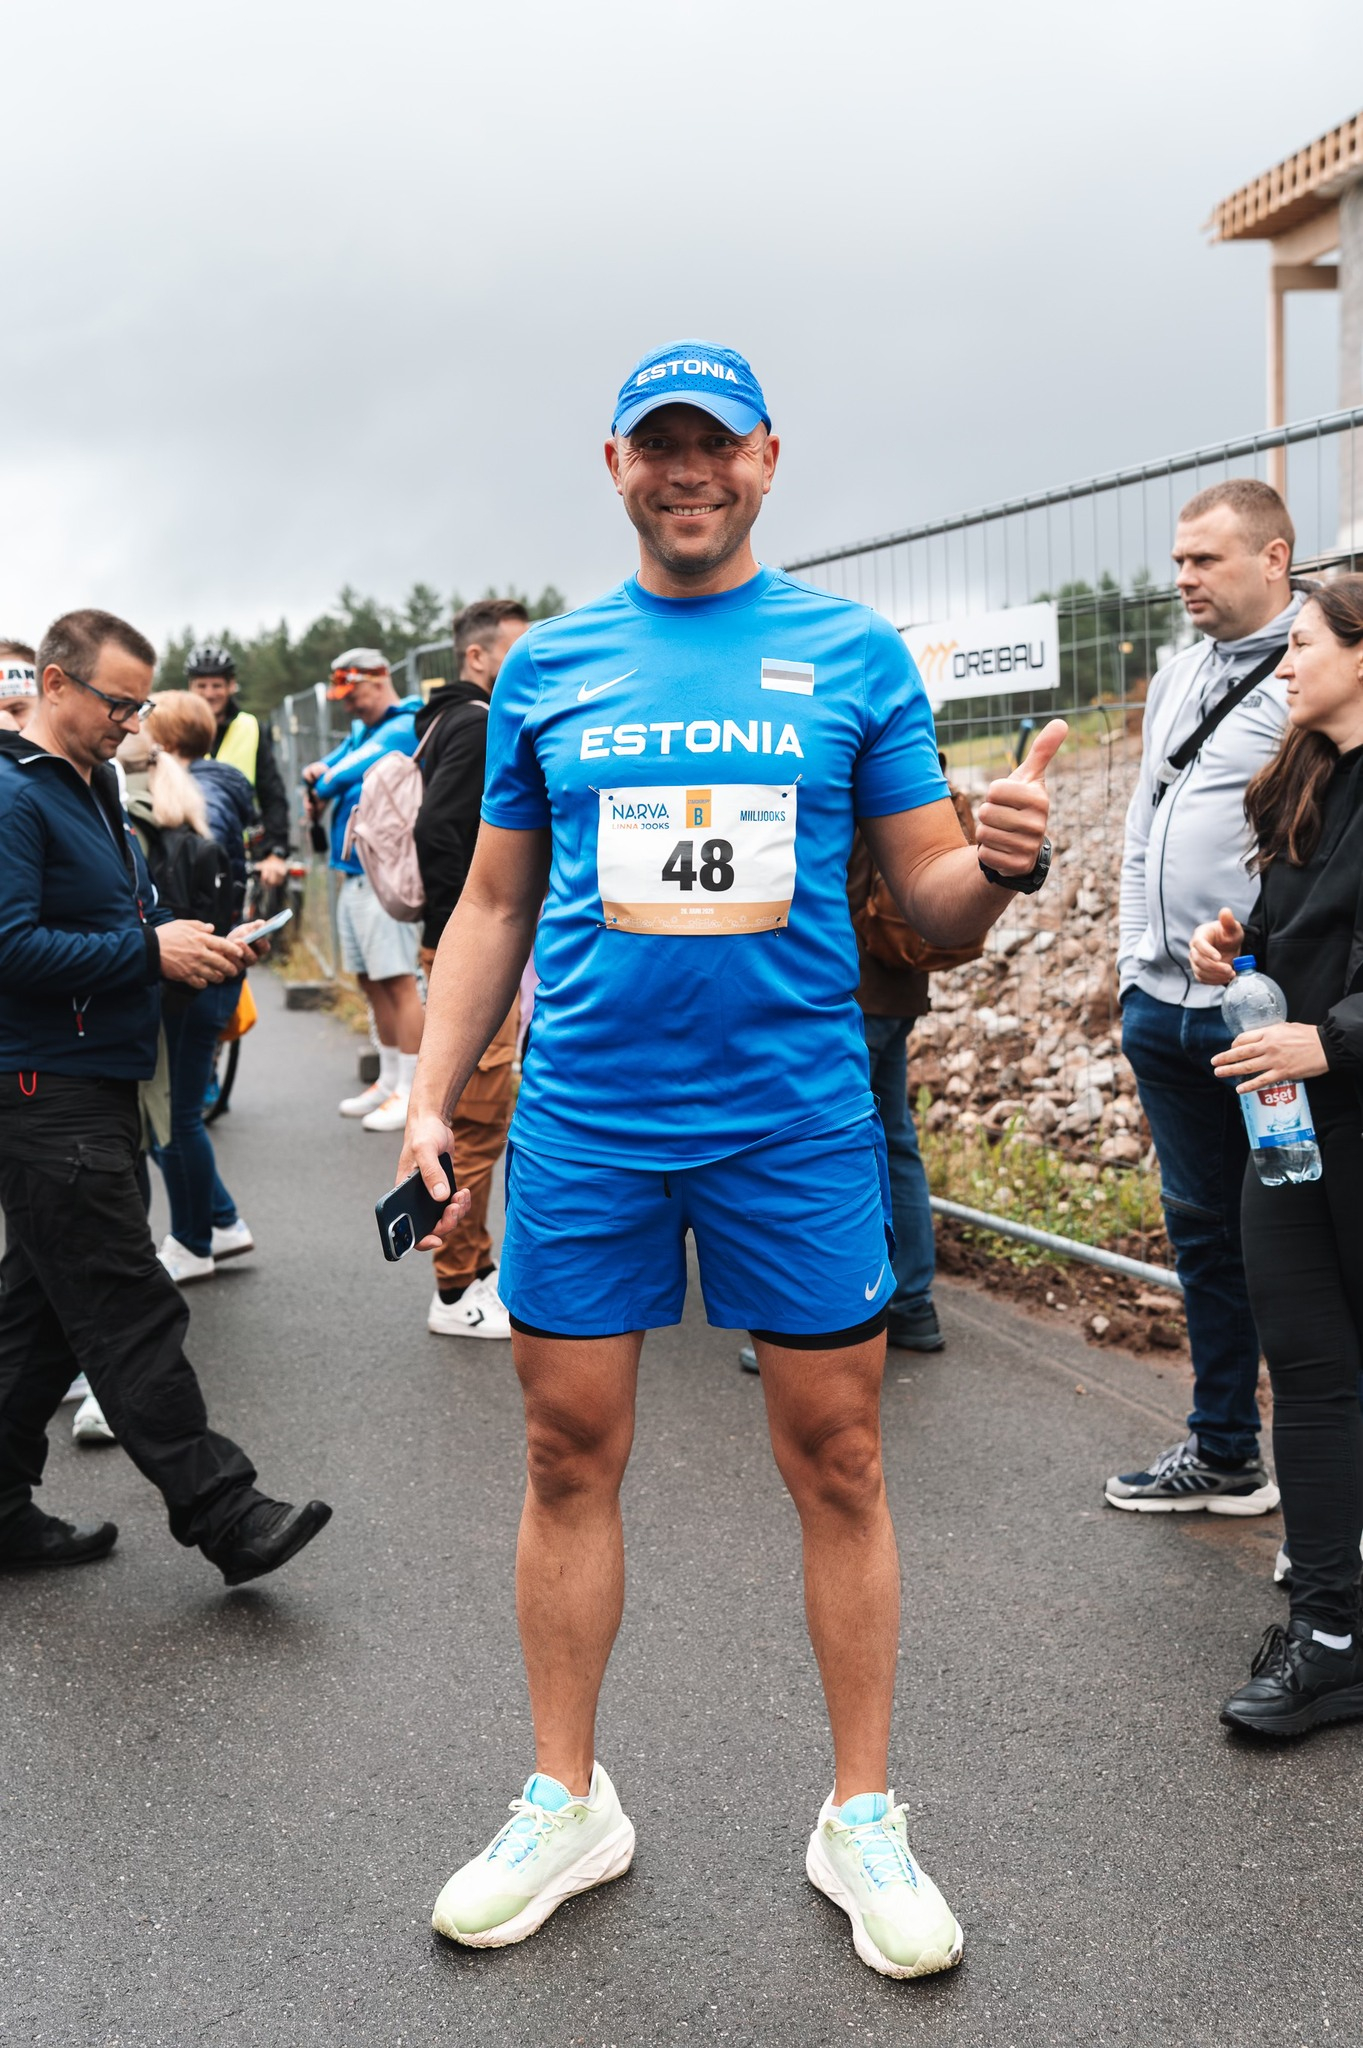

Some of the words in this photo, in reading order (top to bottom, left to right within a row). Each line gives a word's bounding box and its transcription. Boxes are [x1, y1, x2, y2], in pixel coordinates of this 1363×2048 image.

[636, 359, 738, 386] ESTONIA
[953, 640, 1044, 679] DREIBAU
[579, 719, 804, 760] ESTONIA
[612, 803, 669, 820] NARVA
[694, 807, 703, 826] B
[740, 810, 786, 822] MIILIJOOKS
[640, 822, 670, 830] JOOKS
[661, 838, 735, 892] 48
[1264, 1088, 1294, 1104] aset
